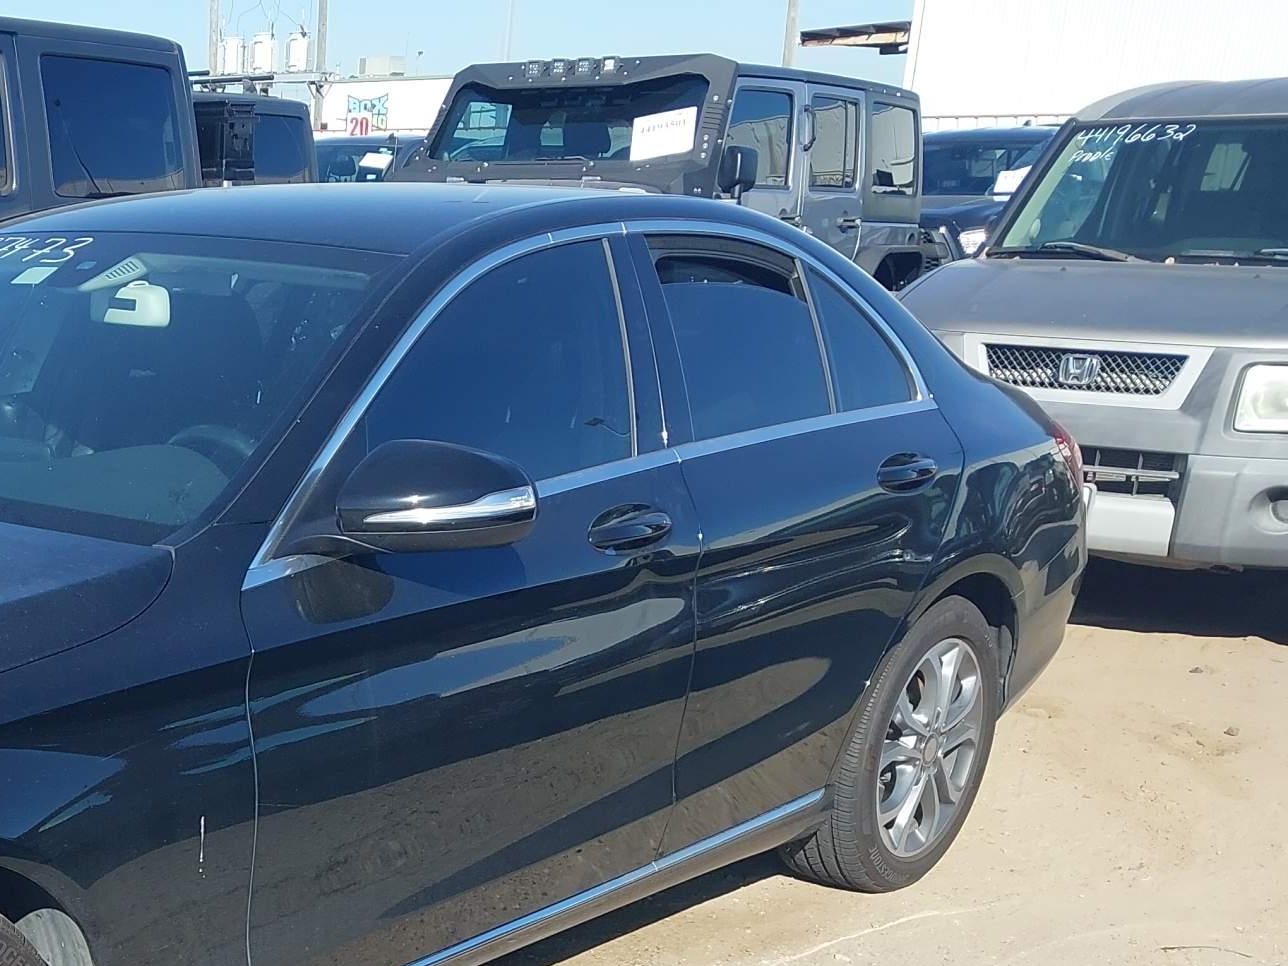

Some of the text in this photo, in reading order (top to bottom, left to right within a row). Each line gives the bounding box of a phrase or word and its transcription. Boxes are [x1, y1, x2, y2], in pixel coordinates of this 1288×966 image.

[347, 93, 389, 115] BOX
[349, 116, 369, 137] 20
[1077, 123, 1197, 147] 44196632
